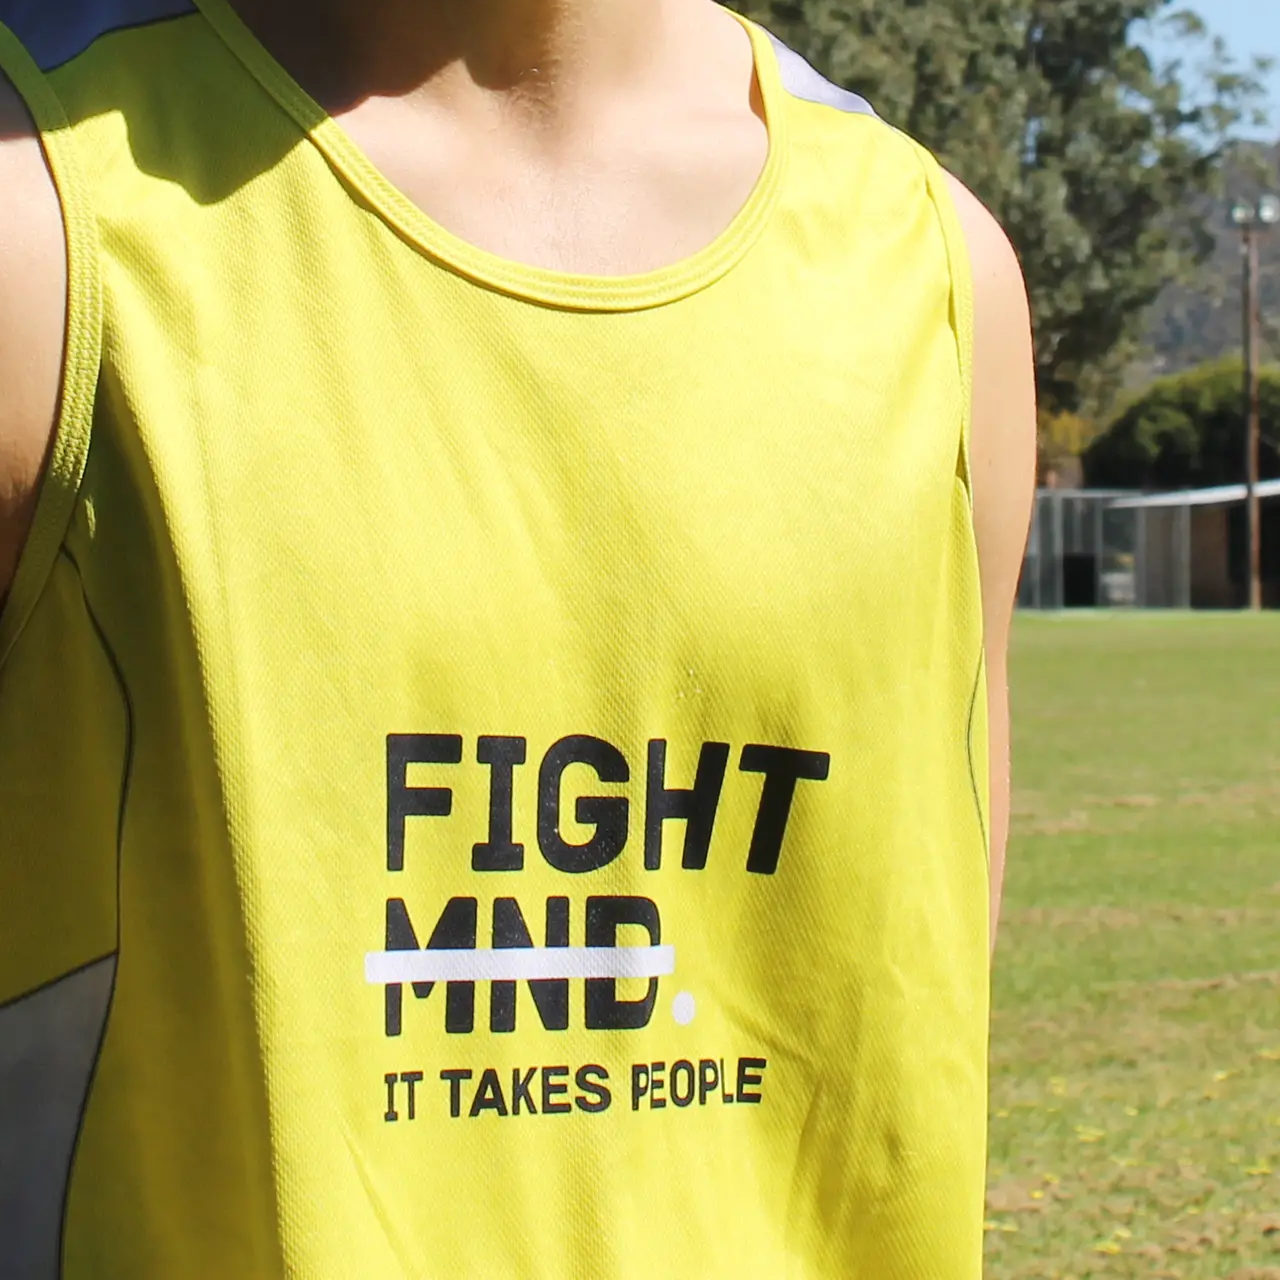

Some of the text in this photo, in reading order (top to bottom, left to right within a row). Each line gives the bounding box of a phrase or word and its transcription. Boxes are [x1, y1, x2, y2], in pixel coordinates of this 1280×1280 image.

[386, 733, 831, 874] FIGHT
[384, 1058, 767, 1122] IT TAKES PEOPLE
